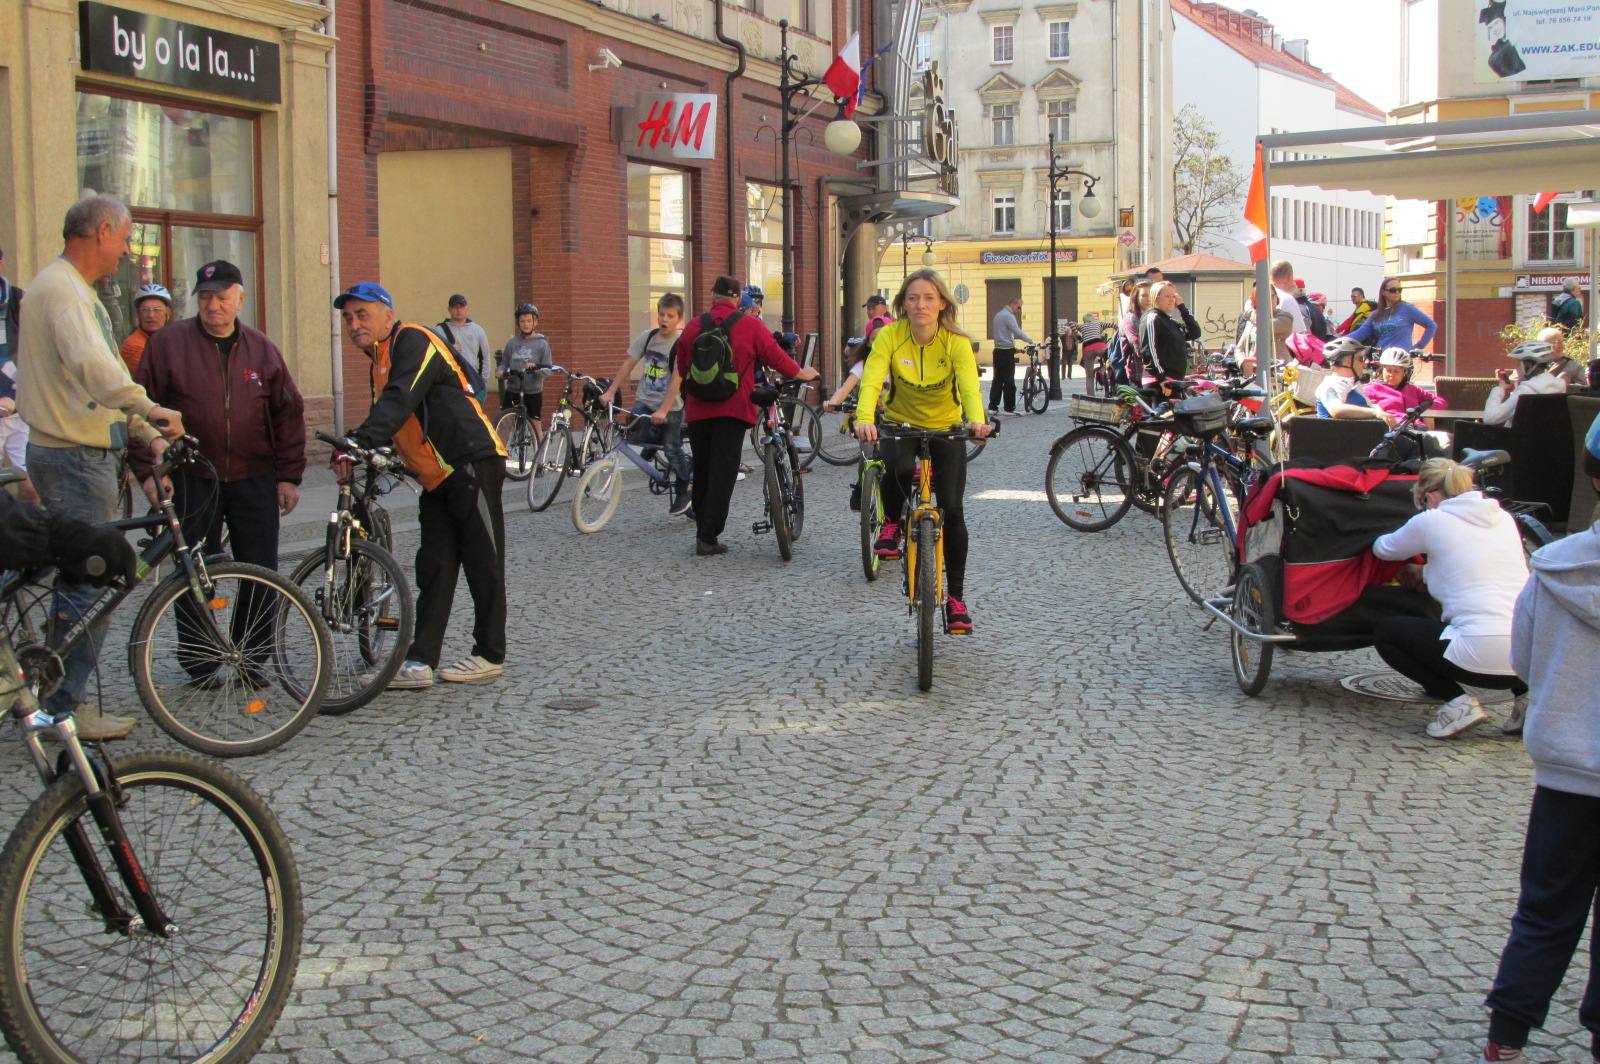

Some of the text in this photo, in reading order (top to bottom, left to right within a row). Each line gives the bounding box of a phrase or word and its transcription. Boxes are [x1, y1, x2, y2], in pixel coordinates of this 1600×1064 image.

[113, 15, 255, 82] by o la la...!
[637, 100, 711, 151] H&M
